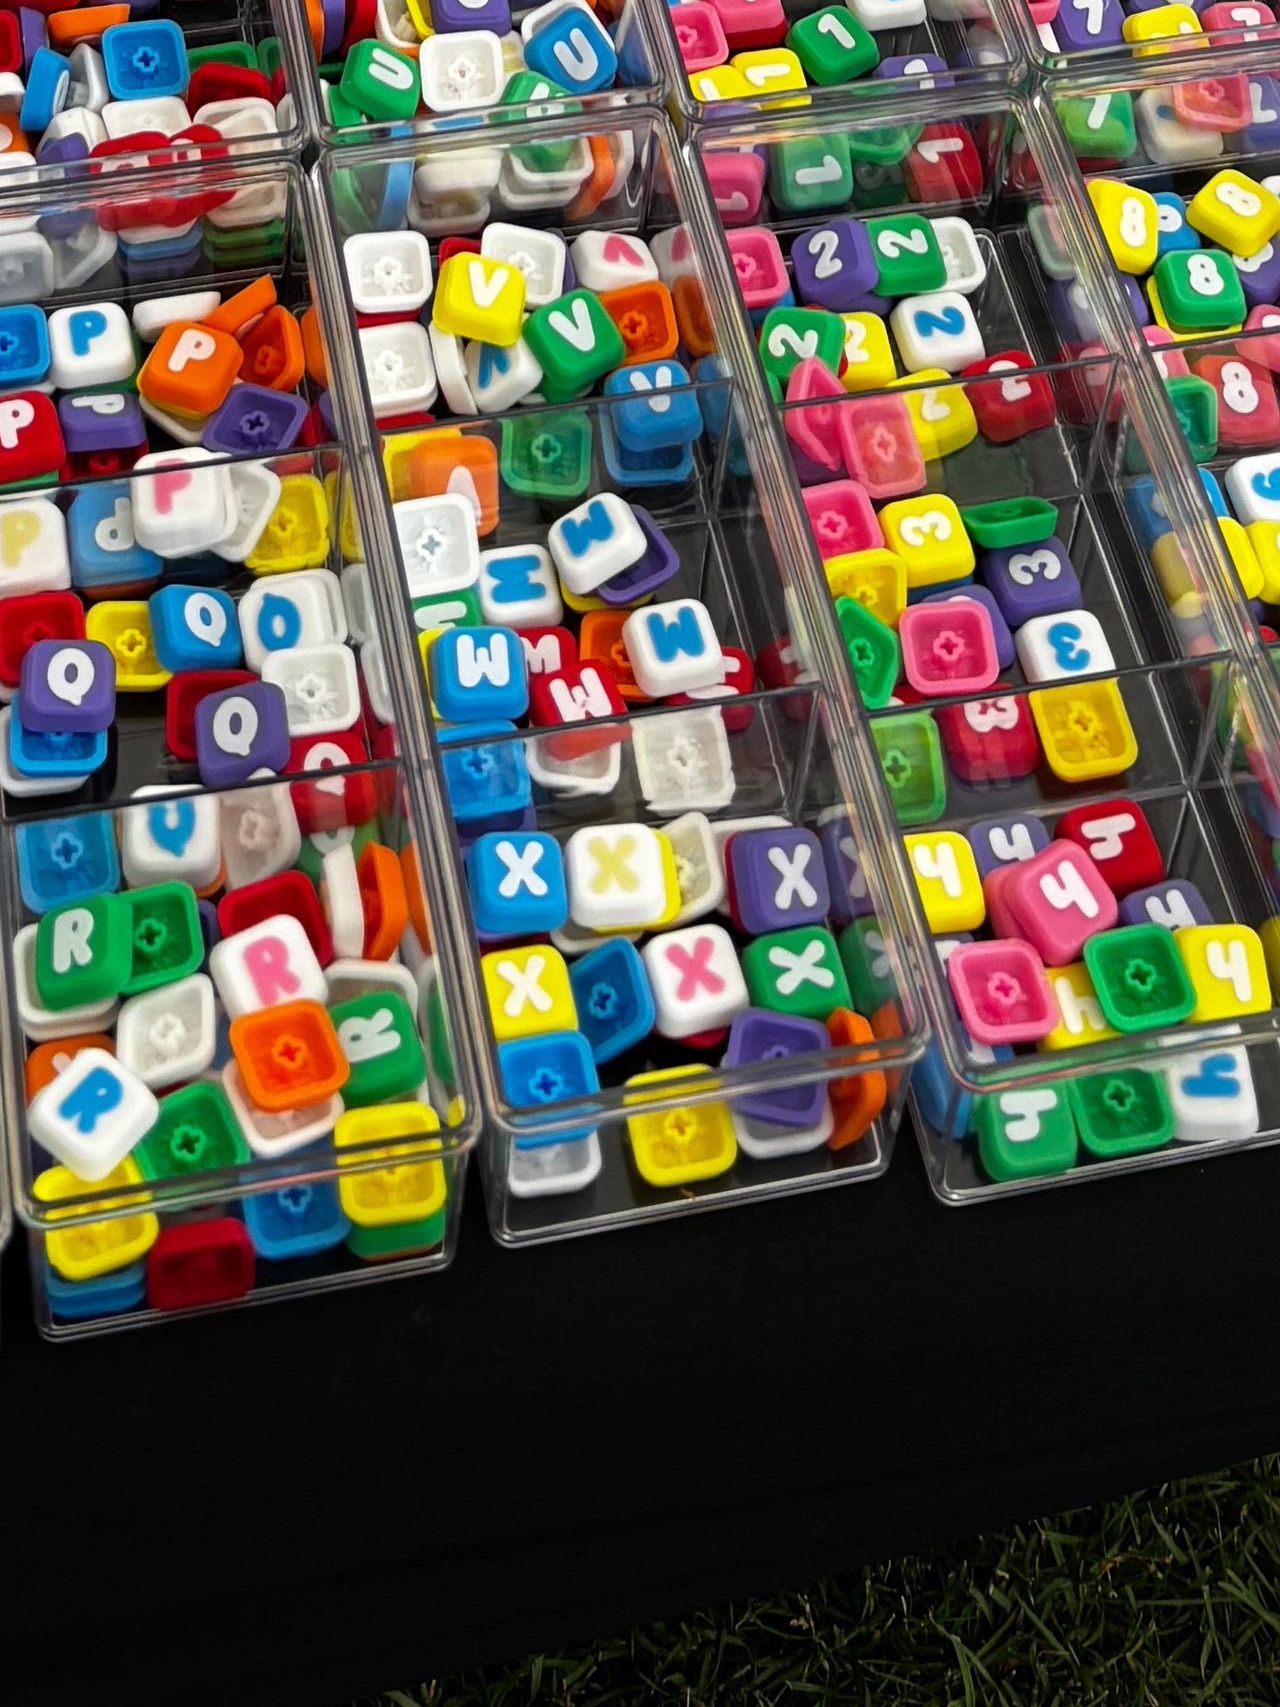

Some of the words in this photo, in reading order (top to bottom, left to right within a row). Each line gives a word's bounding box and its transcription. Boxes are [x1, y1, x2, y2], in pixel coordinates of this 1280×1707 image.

[554, 28, 598, 81] U
[818, 14, 855, 48] 1
[1120, 198, 1146, 246] 8
[1216, 183, 1261, 216] 8
[809, 231, 842, 278] 2
[1188, 254, 1224, 295] 8
[469, 261, 508, 307] V
[69, 311, 106, 355] P
[168, 330, 215, 371] P
[549, 299, 595, 351] V
[768, 323, 818, 359] 2
[629, 366, 672, 410] V
[1222, 362, 1258, 413] 8
[152, 467, 191, 514] P
[0, 512, 40, 566] P
[561, 501, 613, 556] W
[184, 593, 226, 646] Q
[647, 608, 704, 661] W
[457, 634, 509, 687] W
[1048, 623, 1089, 670] 3
[48, 648, 94, 705] Q
[550, 668, 612, 722] W
[213, 697, 258, 755] Q
[589, 838, 637, 893] X
[989, 824, 1034, 860] 4
[496, 842, 547, 897] X
[769, 844, 817, 909] X
[912, 843, 961, 897] 4
[1040, 861, 1098, 917] 4
[53, 909, 93, 973] R
[769, 940, 834, 994] X
[243, 935, 301, 1005] R
[497, 956, 552, 1016] X
[666, 937, 724, 1000] X
[1207, 941, 1251, 1002] 4
[338, 1009, 401, 1063] R
[59, 1068, 122, 1133] R
